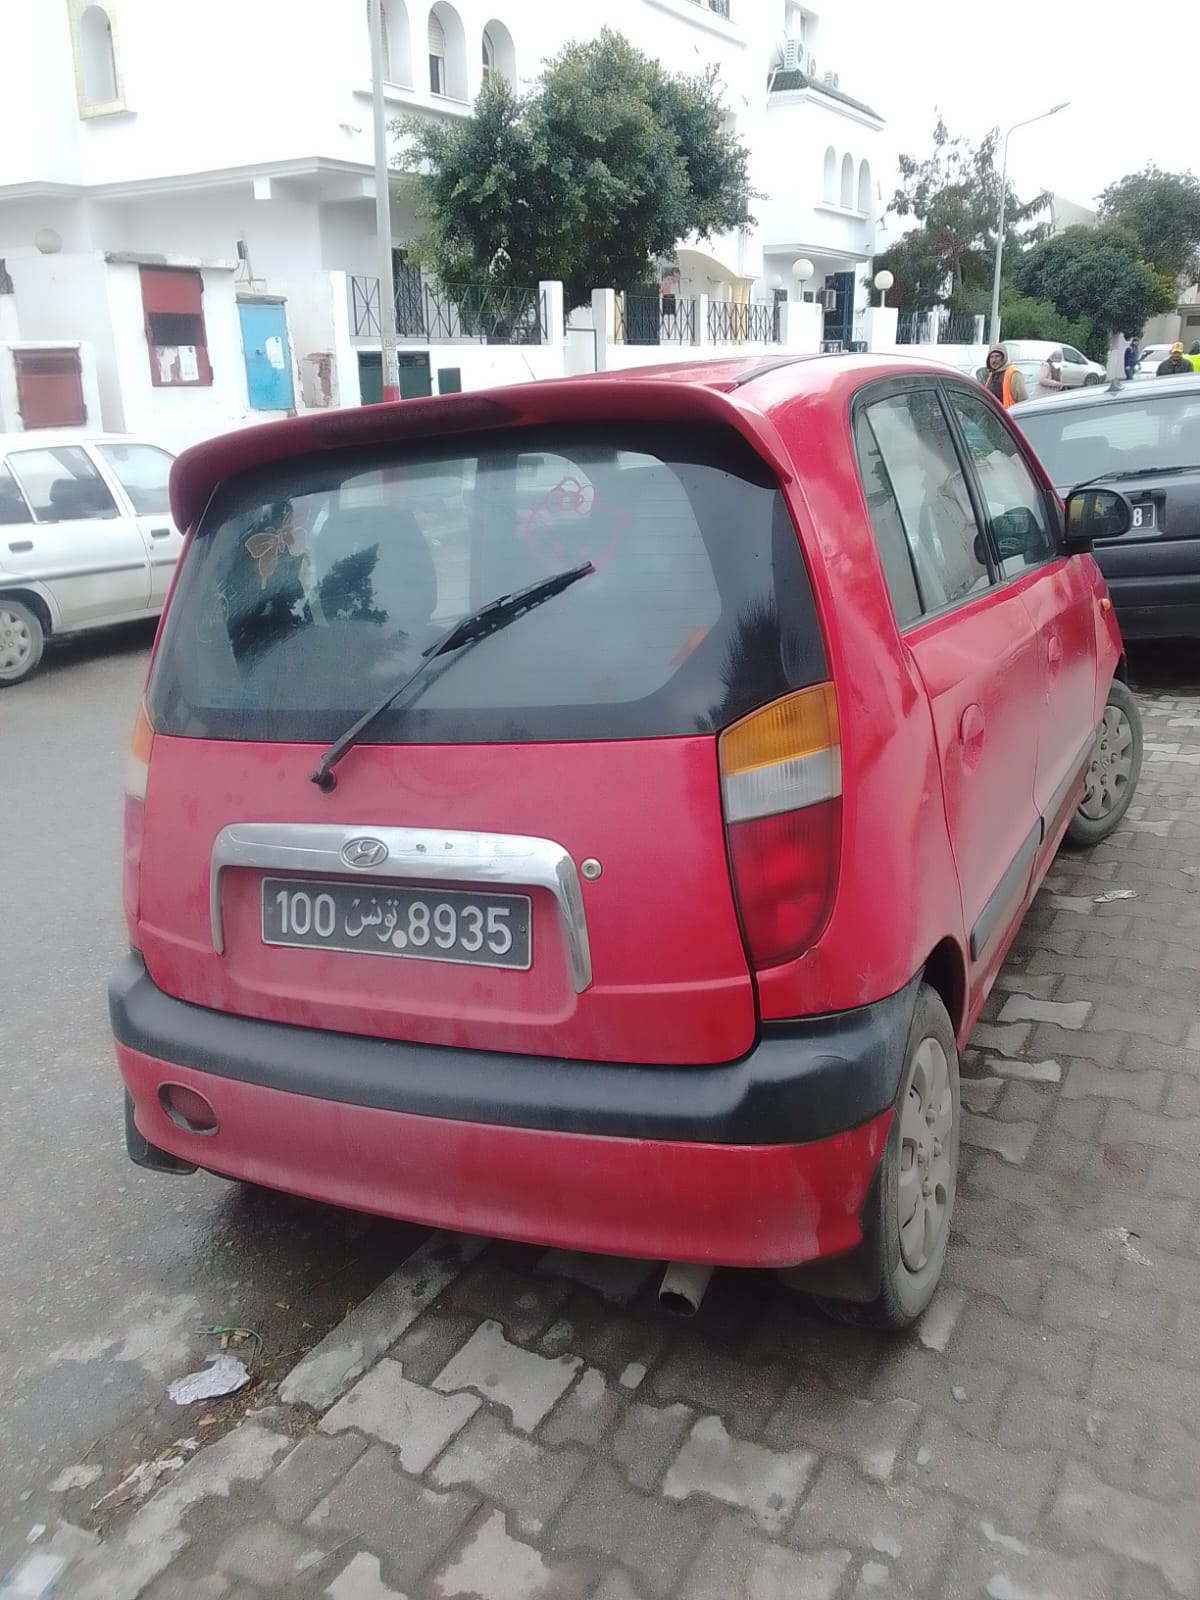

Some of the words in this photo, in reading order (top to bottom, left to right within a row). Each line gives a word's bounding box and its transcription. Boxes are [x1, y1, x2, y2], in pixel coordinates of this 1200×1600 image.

[276, 890, 336, 937] 100
[345, 898, 400, 942] تونس
[407, 901, 513, 955] 8935
